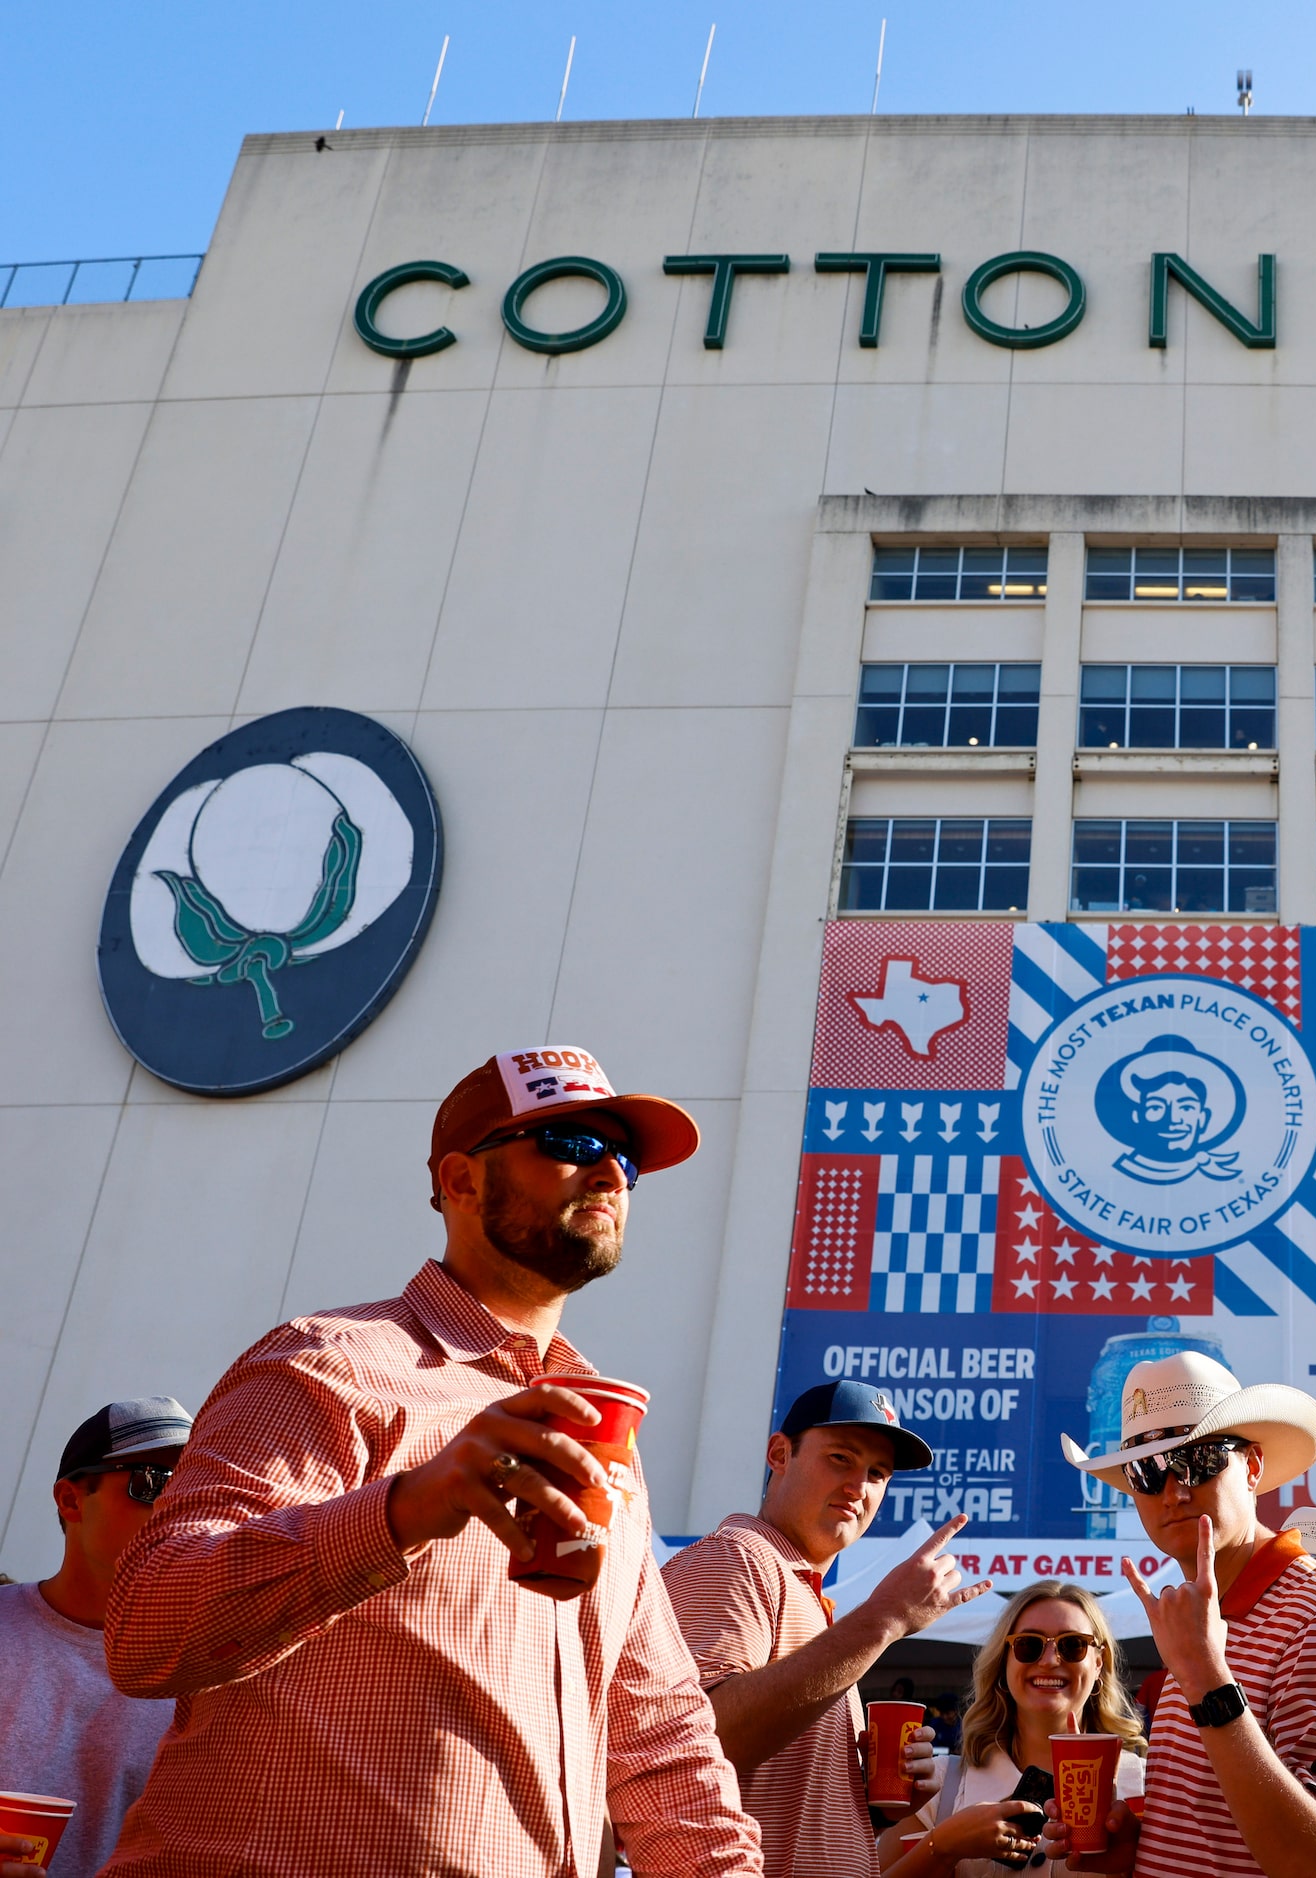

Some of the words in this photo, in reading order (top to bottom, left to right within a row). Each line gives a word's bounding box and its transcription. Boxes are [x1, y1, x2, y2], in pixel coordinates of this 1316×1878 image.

[353, 251, 1278, 358] COTTON
[1089, 993, 1175, 1029] TEXAN
[1180, 994, 1251, 1030] PLACE
[1047, 1023, 1093, 1079] MOST
[1250, 1025, 1282, 1057] ON
[1038, 1082, 1059, 1124] THE
[1273, 1057, 1303, 1128] EARTH
[1058, 1168, 1115, 1221] STATE
[1117, 1210, 1171, 1236] FAIR
[1179, 1213, 1212, 1235] OF
[1215, 1171, 1280, 1224] TEXAS
[823, 1345, 955, 1379] OFFICIAL
[960, 1348, 1036, 1379] BEER
[979, 1388, 1020, 1420] OF
[965, 1448, 1016, 1472] FAIR
[939, 1473, 963, 1486] OF
[887, 1487, 1014, 1522] TEXAS
[988, 1555, 1028, 1576] AT
[1033, 1555, 1113, 1577] GATE
[1062, 1763, 1076, 1820] HOWDY
[1071, 1762, 1094, 1826] FOLKS!
